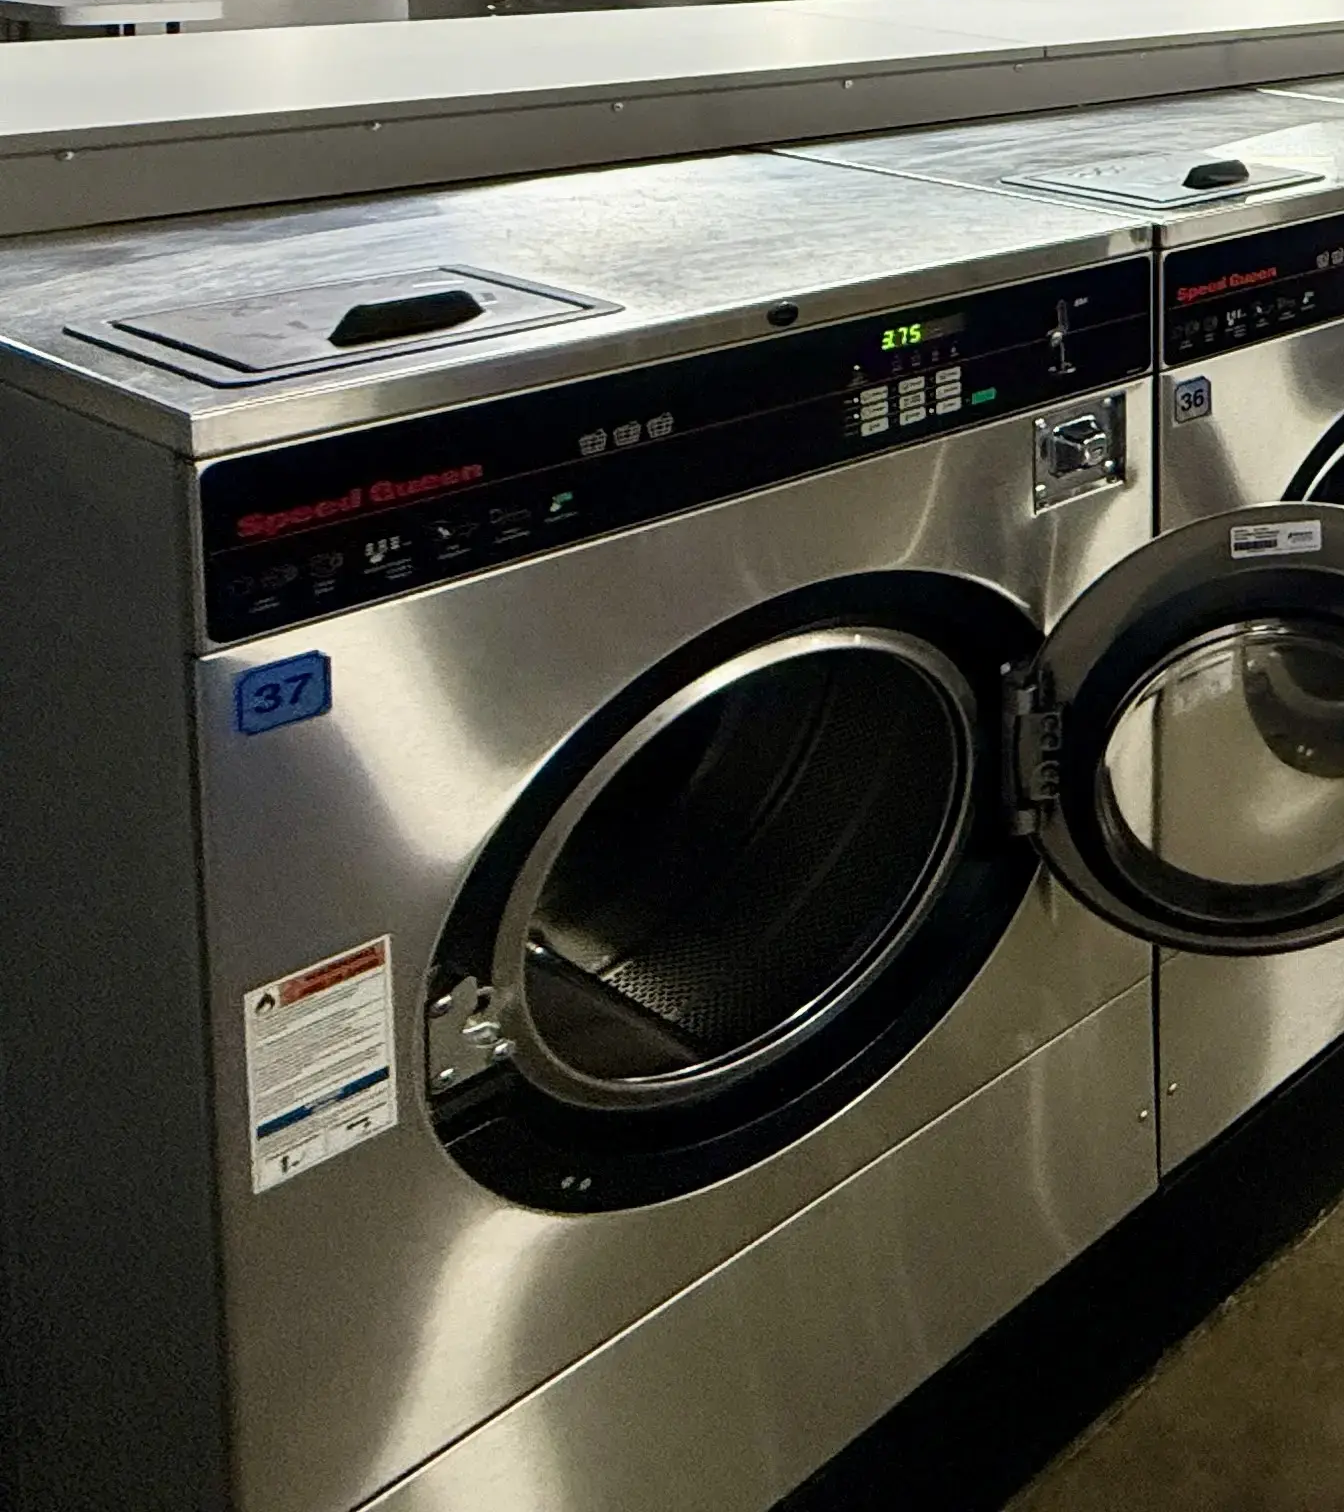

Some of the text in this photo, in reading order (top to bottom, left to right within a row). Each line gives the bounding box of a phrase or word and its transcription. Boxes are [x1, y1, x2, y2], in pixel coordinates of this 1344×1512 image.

[1176, 267, 1277, 302] Speed Queen
[1180, 389, 1205, 412] 36
[237, 464, 484, 538] Speed Queen
[253, 672, 314, 713] 37
